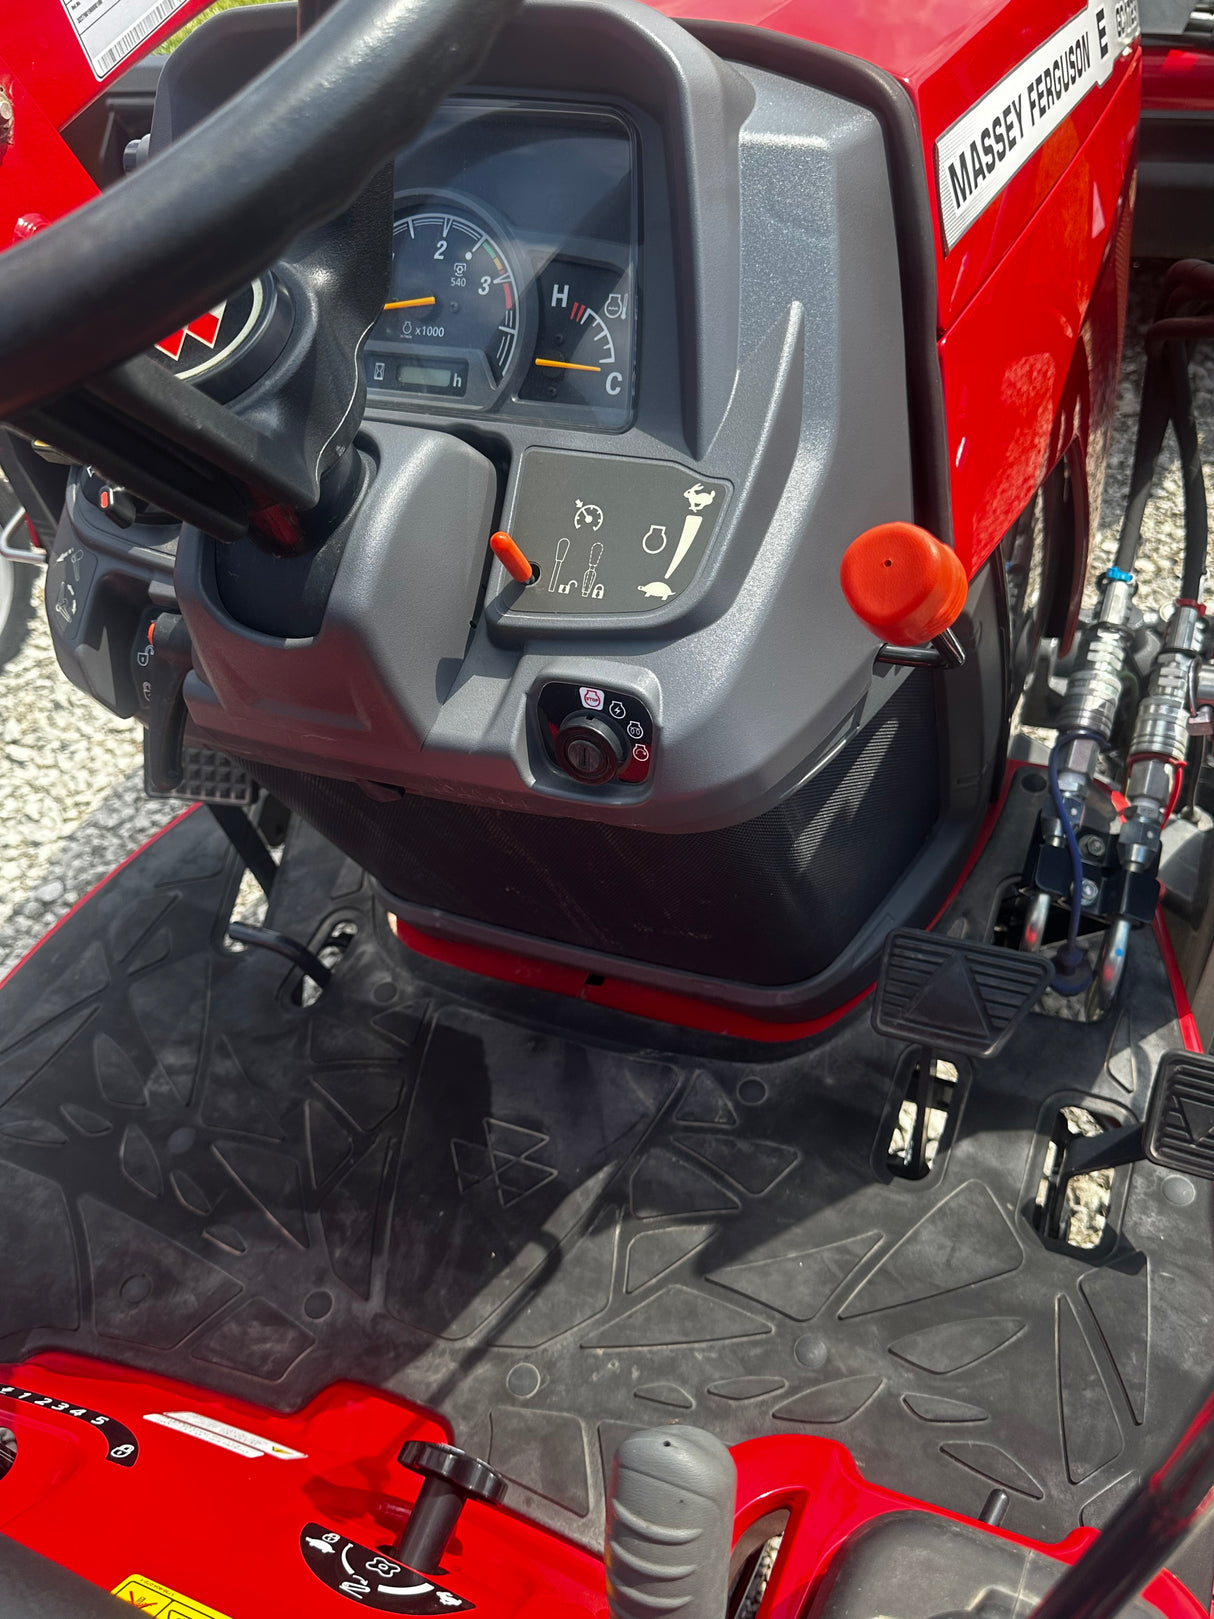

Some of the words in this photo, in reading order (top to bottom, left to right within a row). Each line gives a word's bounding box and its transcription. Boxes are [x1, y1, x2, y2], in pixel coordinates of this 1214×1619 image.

[947, 94, 1025, 210] MASSEY
[1027, 31, 1091, 127] FERGUSON
[433, 240, 448, 260] 2
[450, 277, 467, 288] 540
[478, 276, 492, 296] 3
[551, 284, 569, 308] H
[452, 373, 462, 388] h
[605, 372, 623, 396] C
[18, 1392, 32, 1400] 1
[34, 1397, 53, 1406] 2
[51, 1402, 70, 1411] 3
[69, 1408, 87, 1417] 4
[90, 1416, 110, 1425] 5
